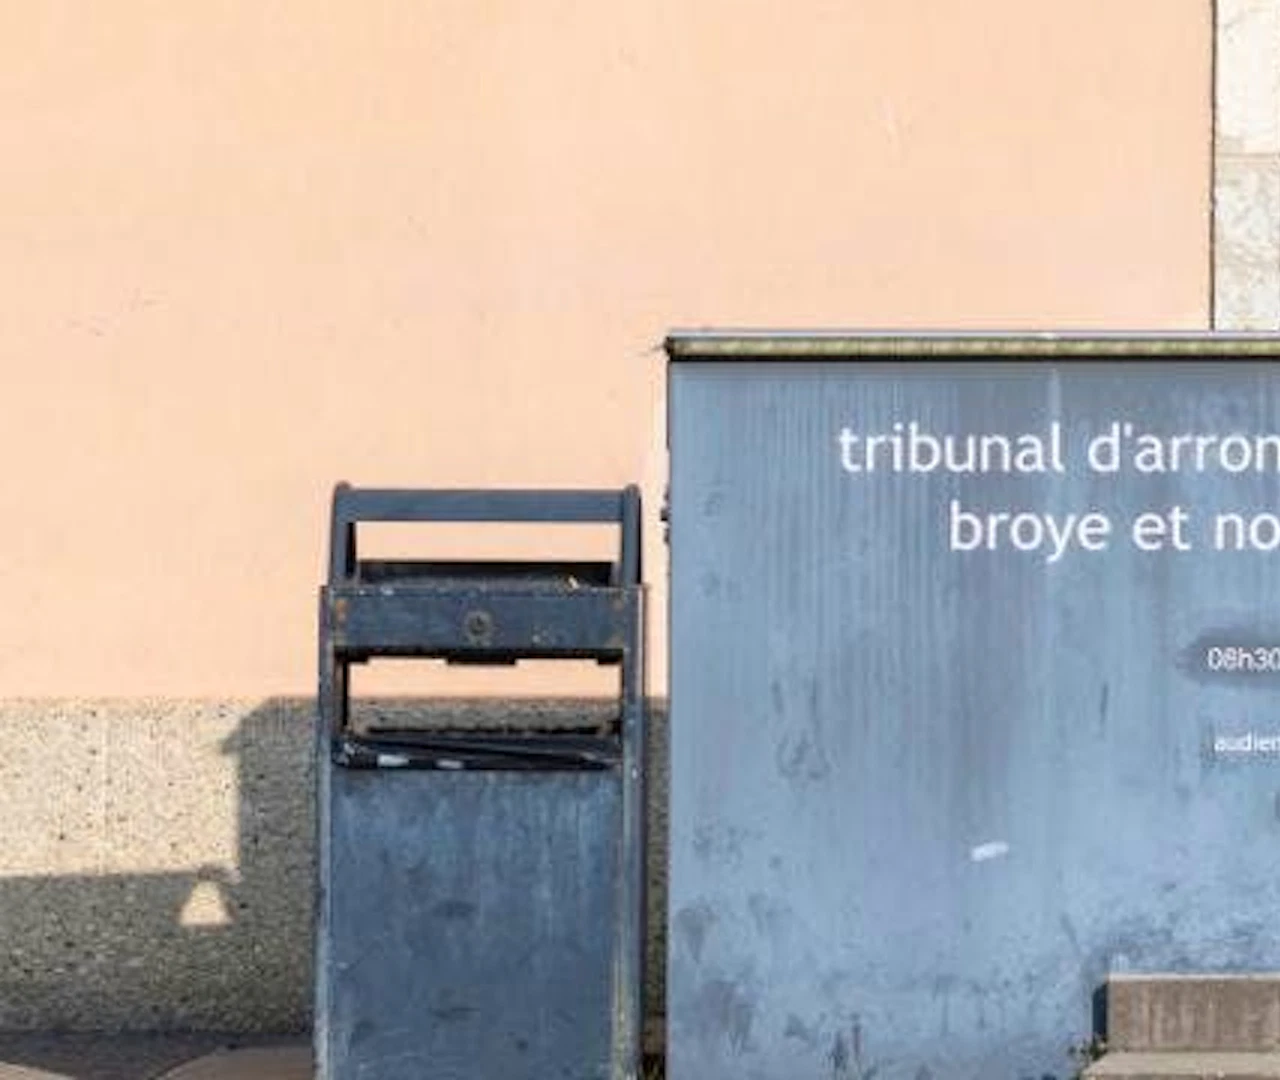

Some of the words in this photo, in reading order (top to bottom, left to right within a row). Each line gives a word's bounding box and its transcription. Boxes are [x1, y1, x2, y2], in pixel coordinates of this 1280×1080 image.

[838, 421, 1065, 472] tribunal
[950, 499, 1111, 563] broye
[1132, 506, 1192, 551] et
